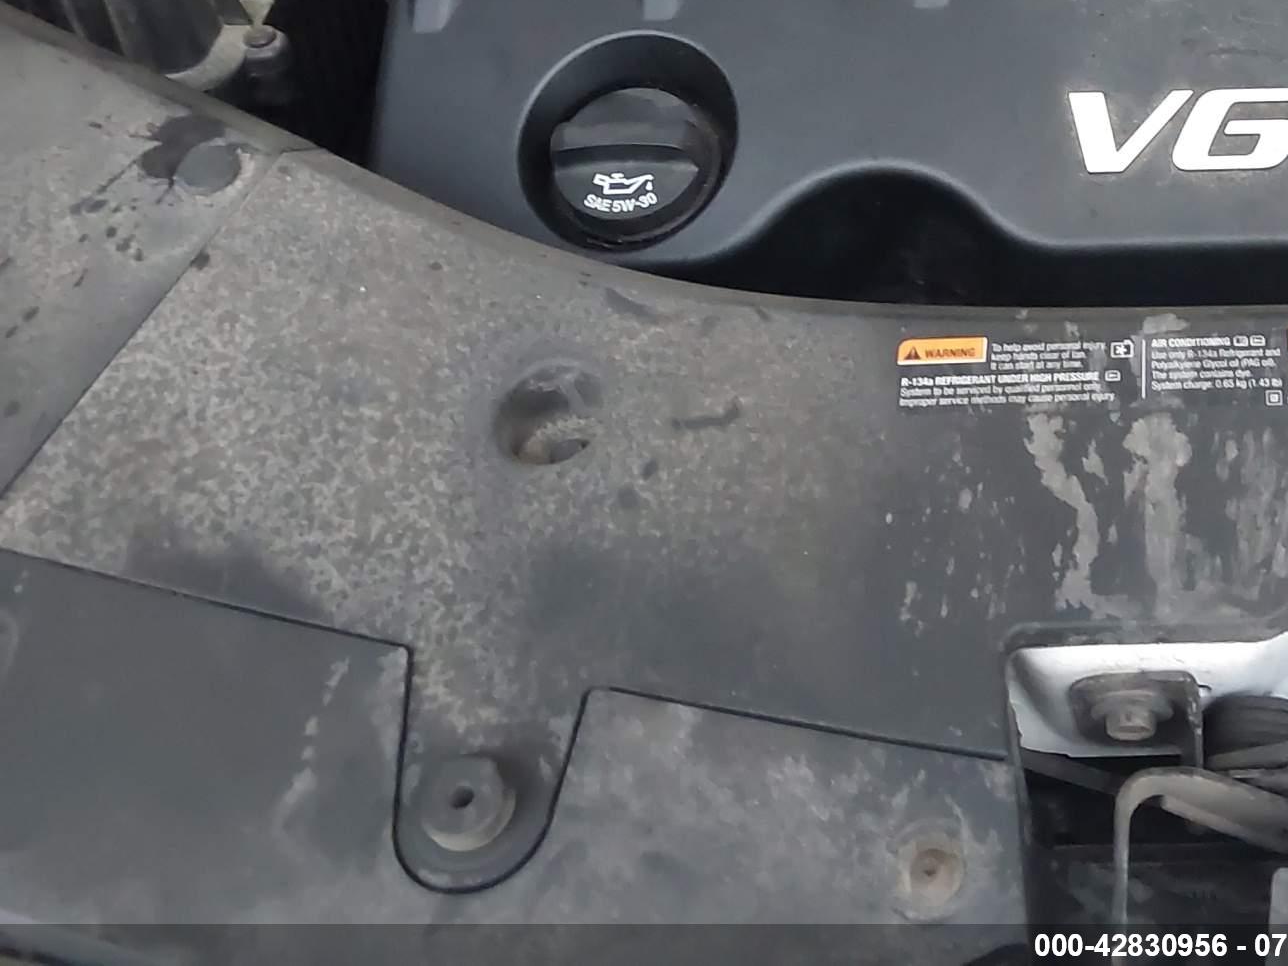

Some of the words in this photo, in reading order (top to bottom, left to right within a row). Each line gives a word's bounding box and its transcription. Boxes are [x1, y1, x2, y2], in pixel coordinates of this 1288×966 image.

[583, 194, 612, 212] SAE
[611, 192, 658, 212] 5W-30
[1151, 338, 1167, 348] AIR
[1168, 336, 1230, 347] CONDITIONING
[925, 347, 976, 358] WARNING
[1152, 350, 1166, 360] Use
[1187, 349, 1217, 359] R-134a
[1265, 347, 1280, 357] and
[1202, 359, 1227, 370] Glycol
[901, 377, 934, 387] R-134a
[935, 375, 996, 386] REFRIGERANT
[997, 374, 1028, 384] UNDER
[1030, 372, 1052, 382] HIGH
[1053, 371, 1100, 382] PRESSURE
[1152, 370, 1167, 379] The
[1168, 370, 1198, 380] system
[1199, 369, 1234, 379] contains
[1151, 380, 1182, 391] System
[1236, 378, 1247, 389] kg
[900, 387, 932, 398] System
[939, 397, 969, 405] service
[971, 395, 1006, 405] methods
[1008, 395, 1026, 404] may
[1027, 394, 1053, 403] cause
